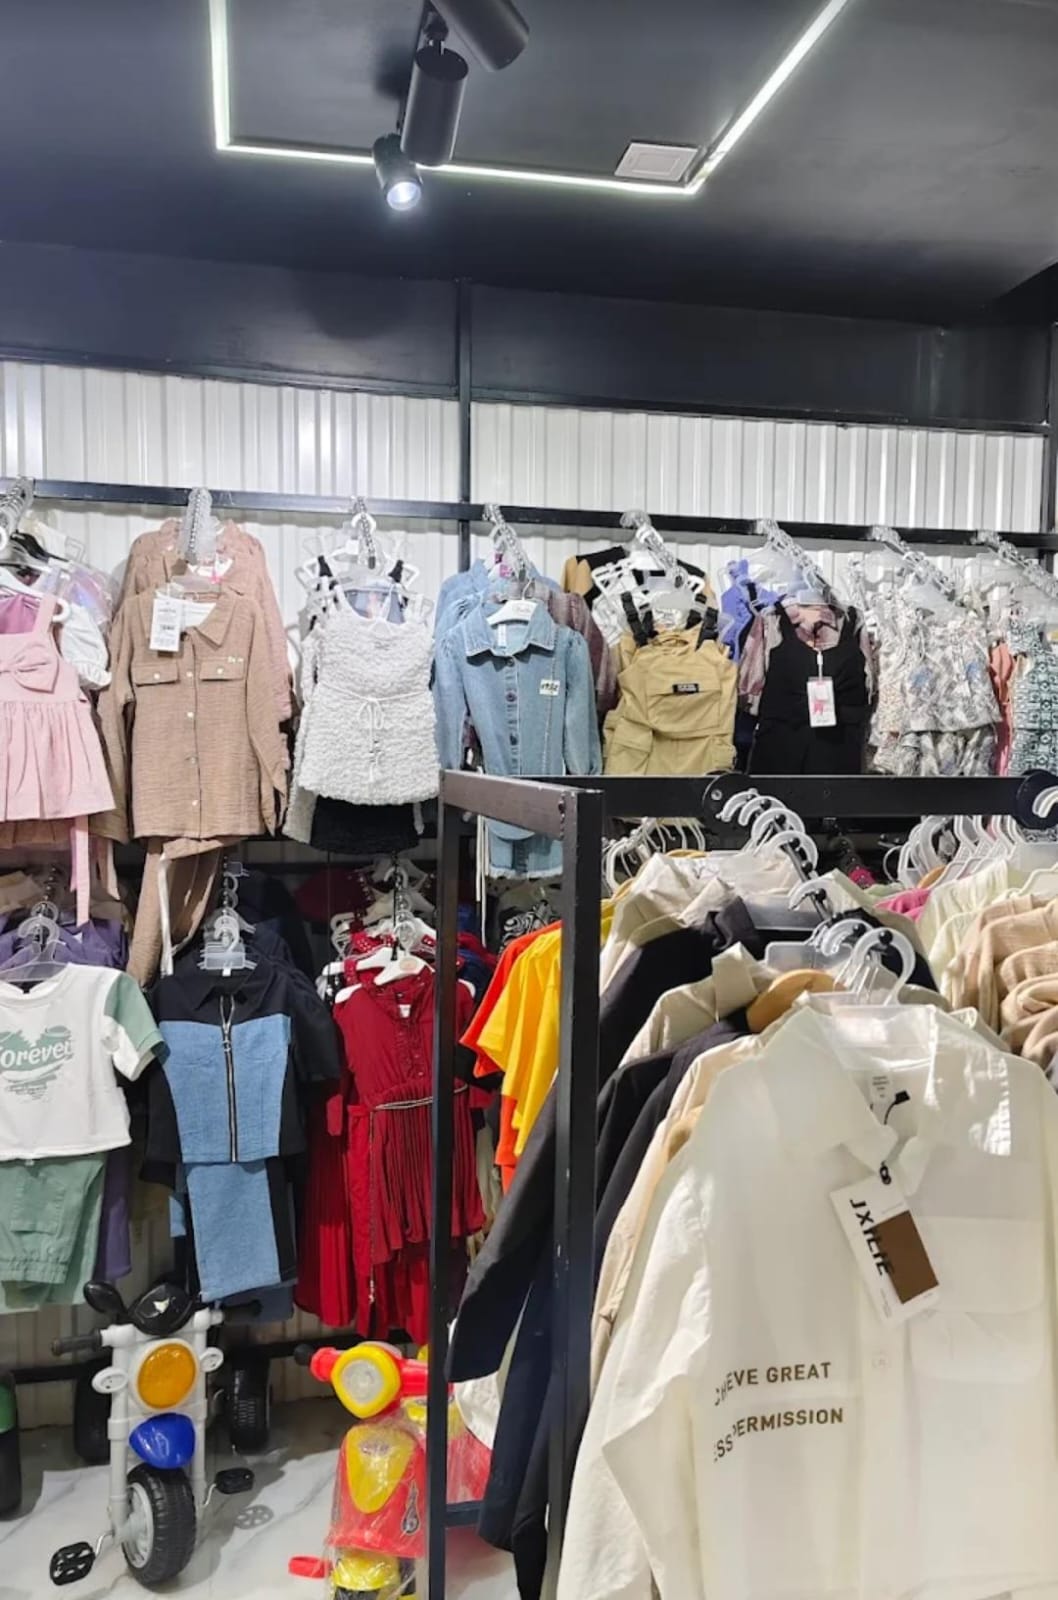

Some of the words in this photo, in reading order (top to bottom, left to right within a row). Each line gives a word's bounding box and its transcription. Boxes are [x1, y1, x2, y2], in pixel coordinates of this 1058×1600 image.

[0, 1040, 72, 1069] oreve
[766, 1361, 831, 1384] GREAT
[712, 1433, 734, 1463] SS
